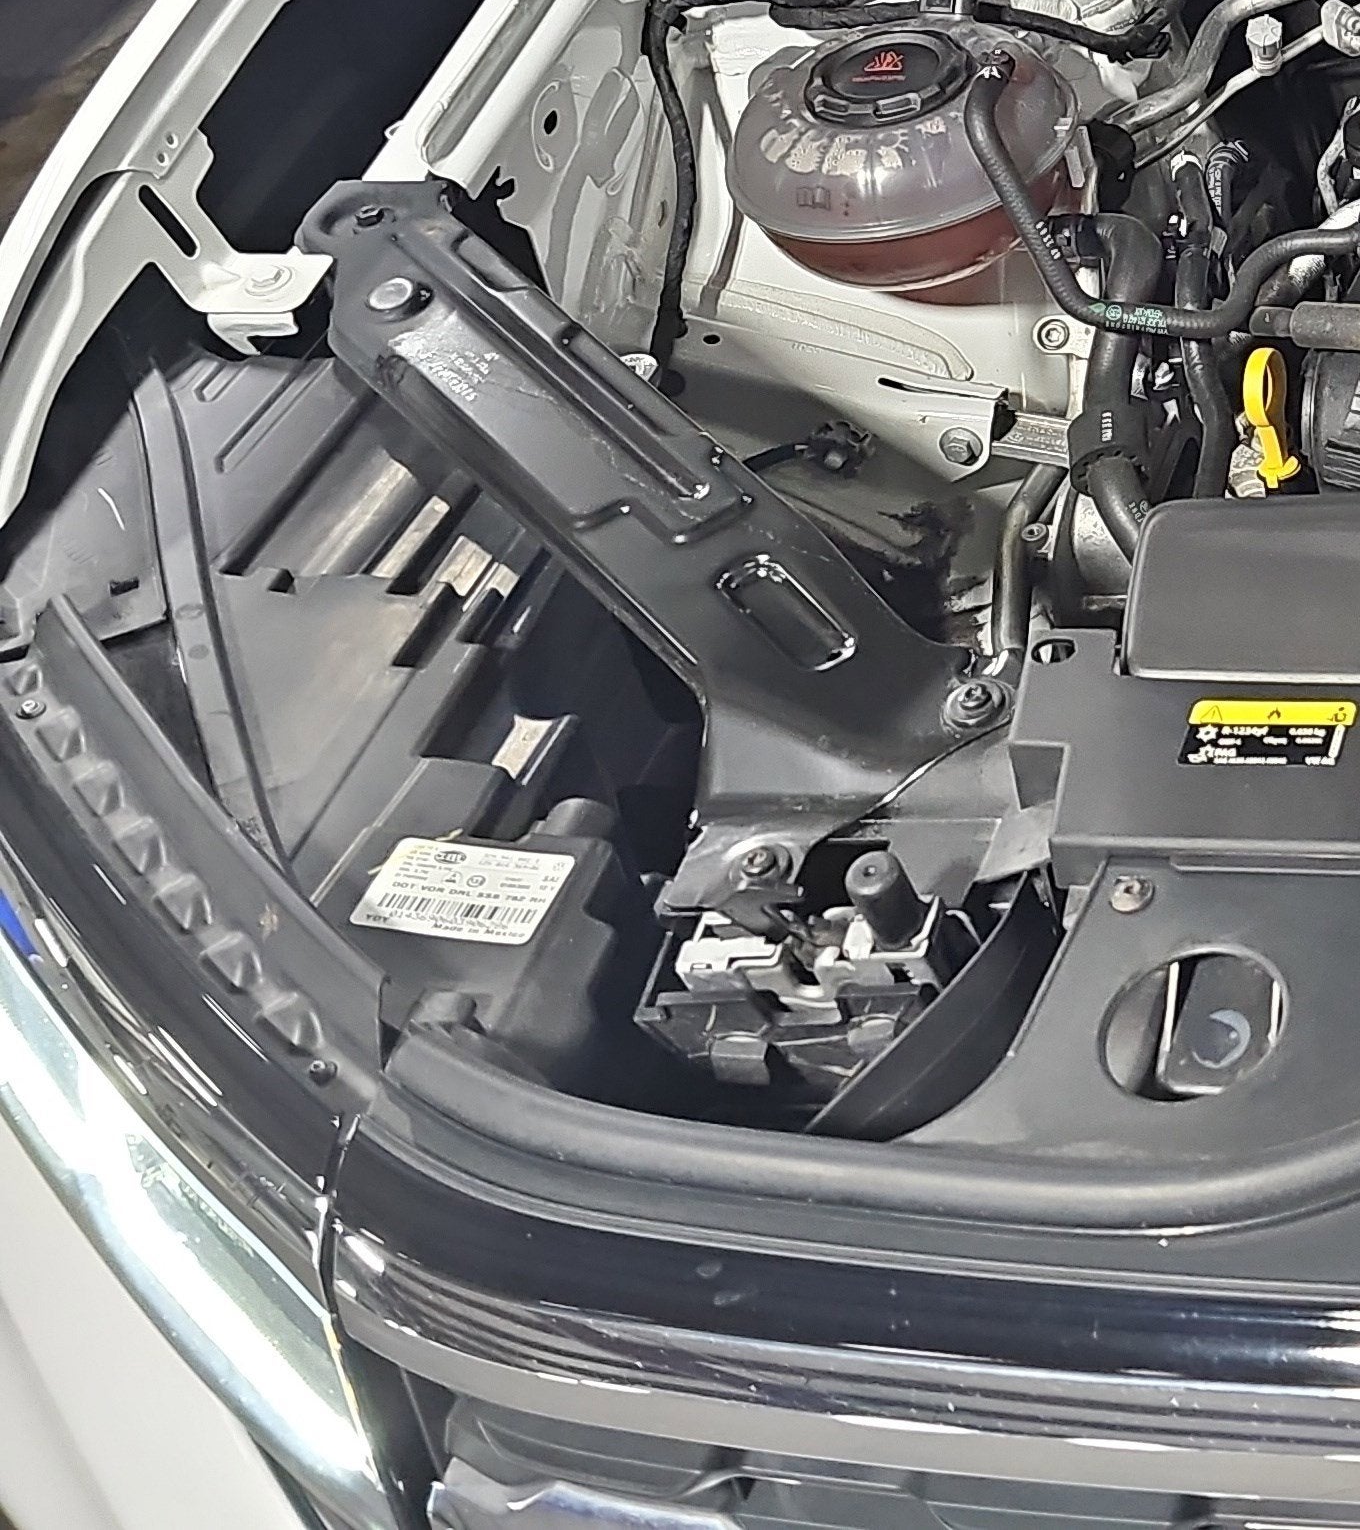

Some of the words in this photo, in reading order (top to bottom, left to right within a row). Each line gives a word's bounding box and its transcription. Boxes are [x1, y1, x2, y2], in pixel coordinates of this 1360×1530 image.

[391, 880, 417, 890] DOT
[431, 923, 464, 933] Made
[467, 926, 480, 934] in
[485, 928, 526, 938] Mexico
